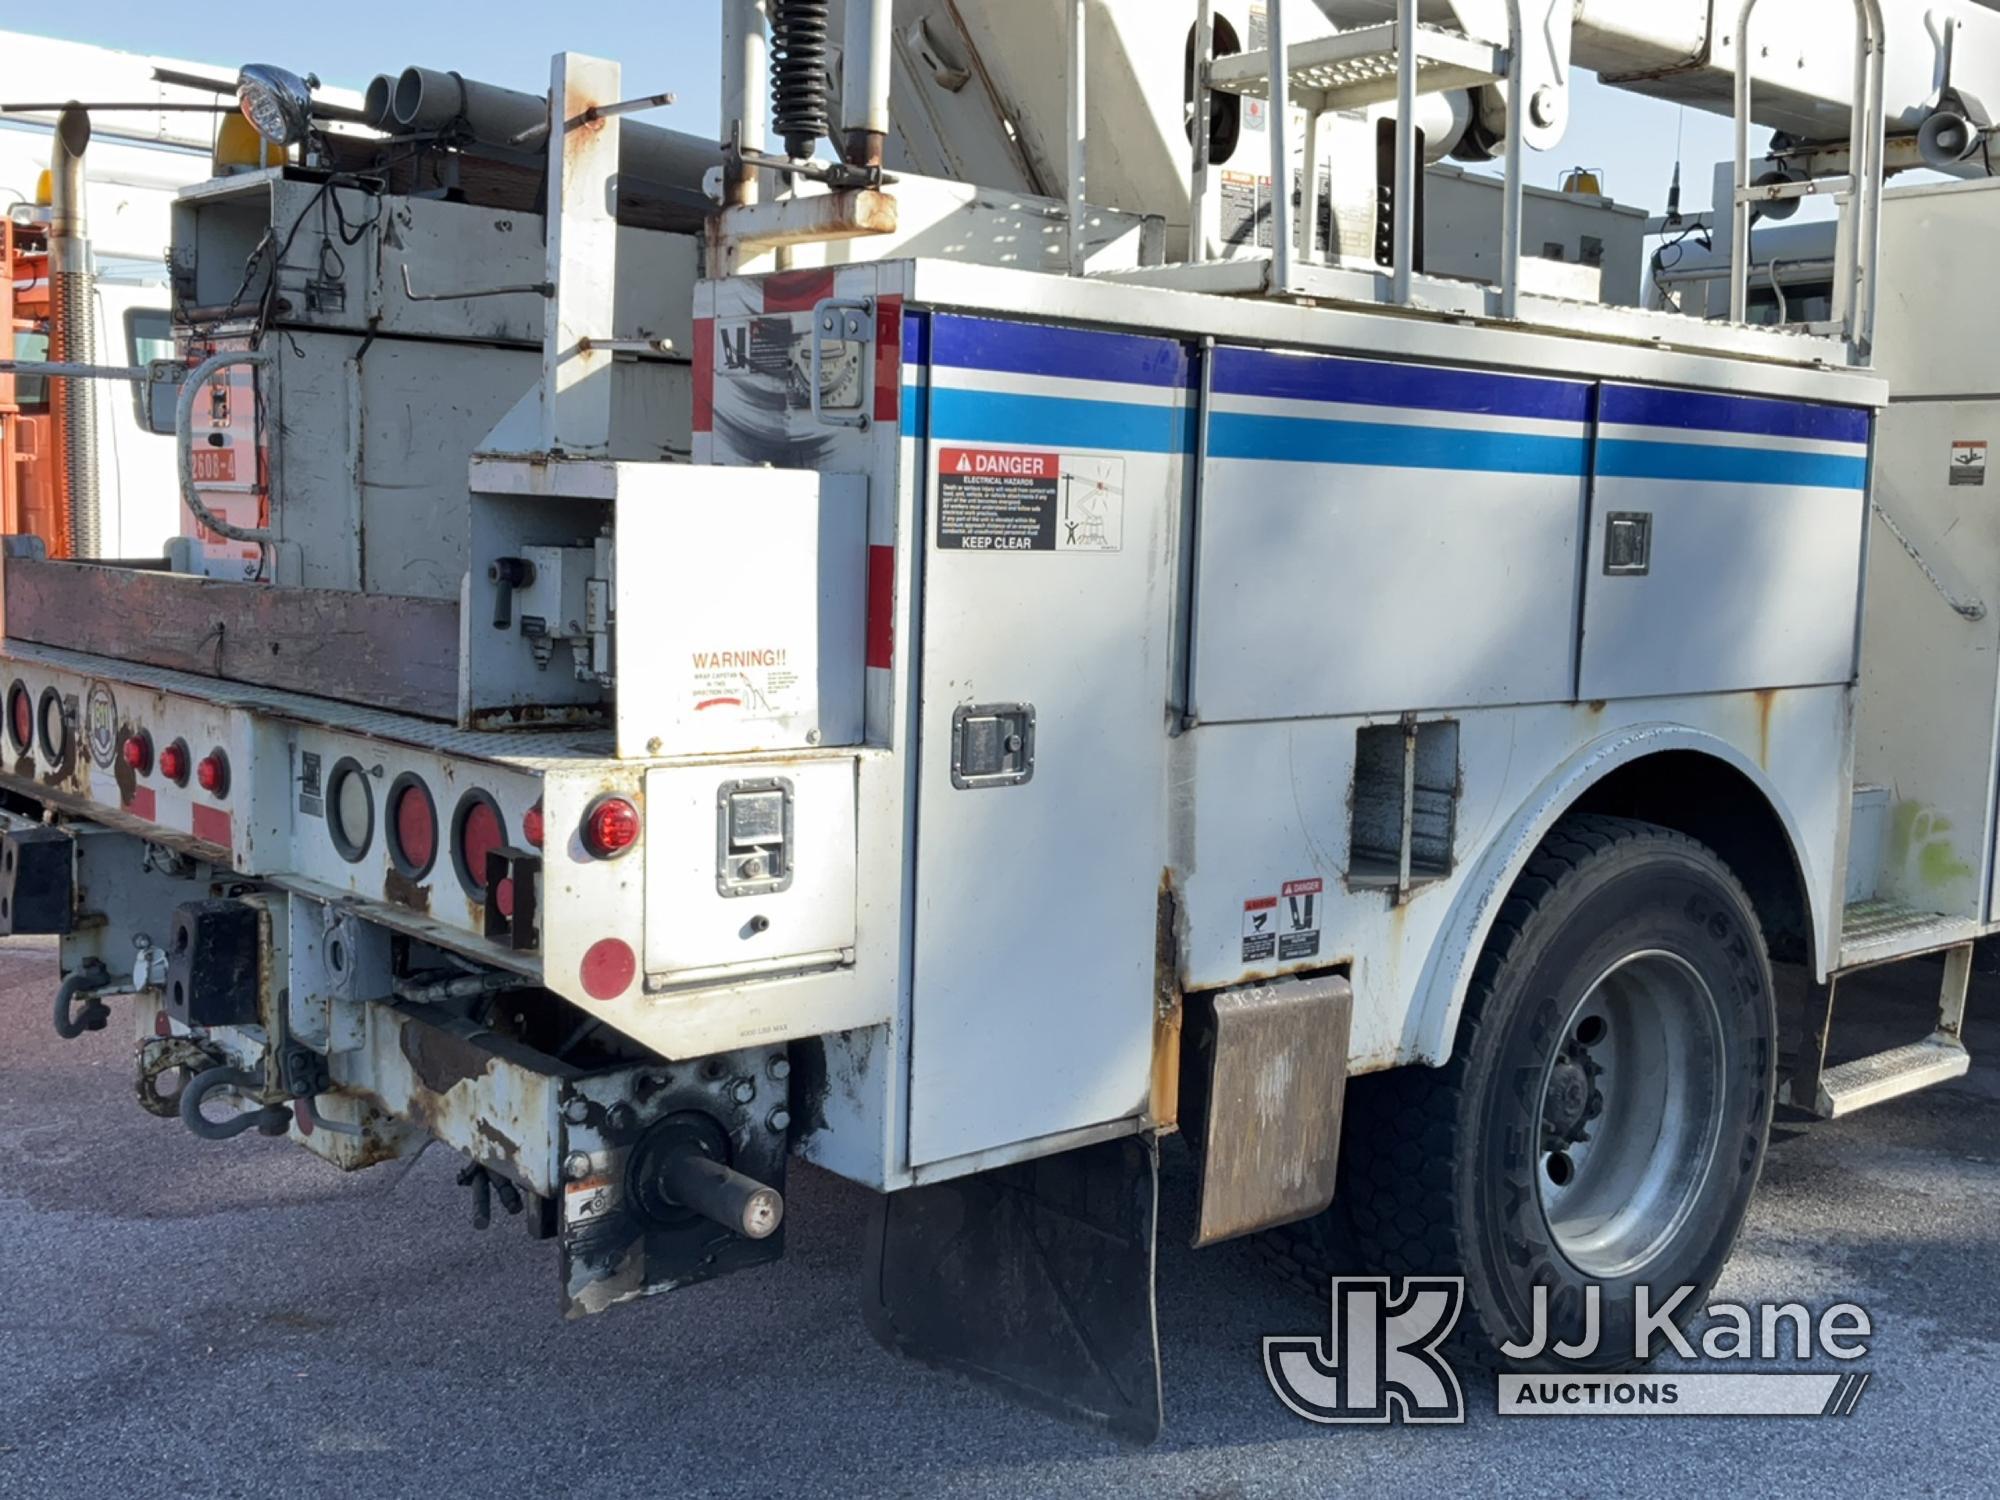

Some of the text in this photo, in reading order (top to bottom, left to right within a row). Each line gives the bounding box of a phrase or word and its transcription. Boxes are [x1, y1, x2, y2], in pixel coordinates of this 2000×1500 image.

[975, 454, 1045, 475] DANGER
[963, 476, 1034, 486] ELECTRICAL HAZARDS
[961, 536, 1032, 550] KEEP CLEAR
[692, 648, 786, 669] WARNING!!
[1293, 881, 1319, 894] DANGER
